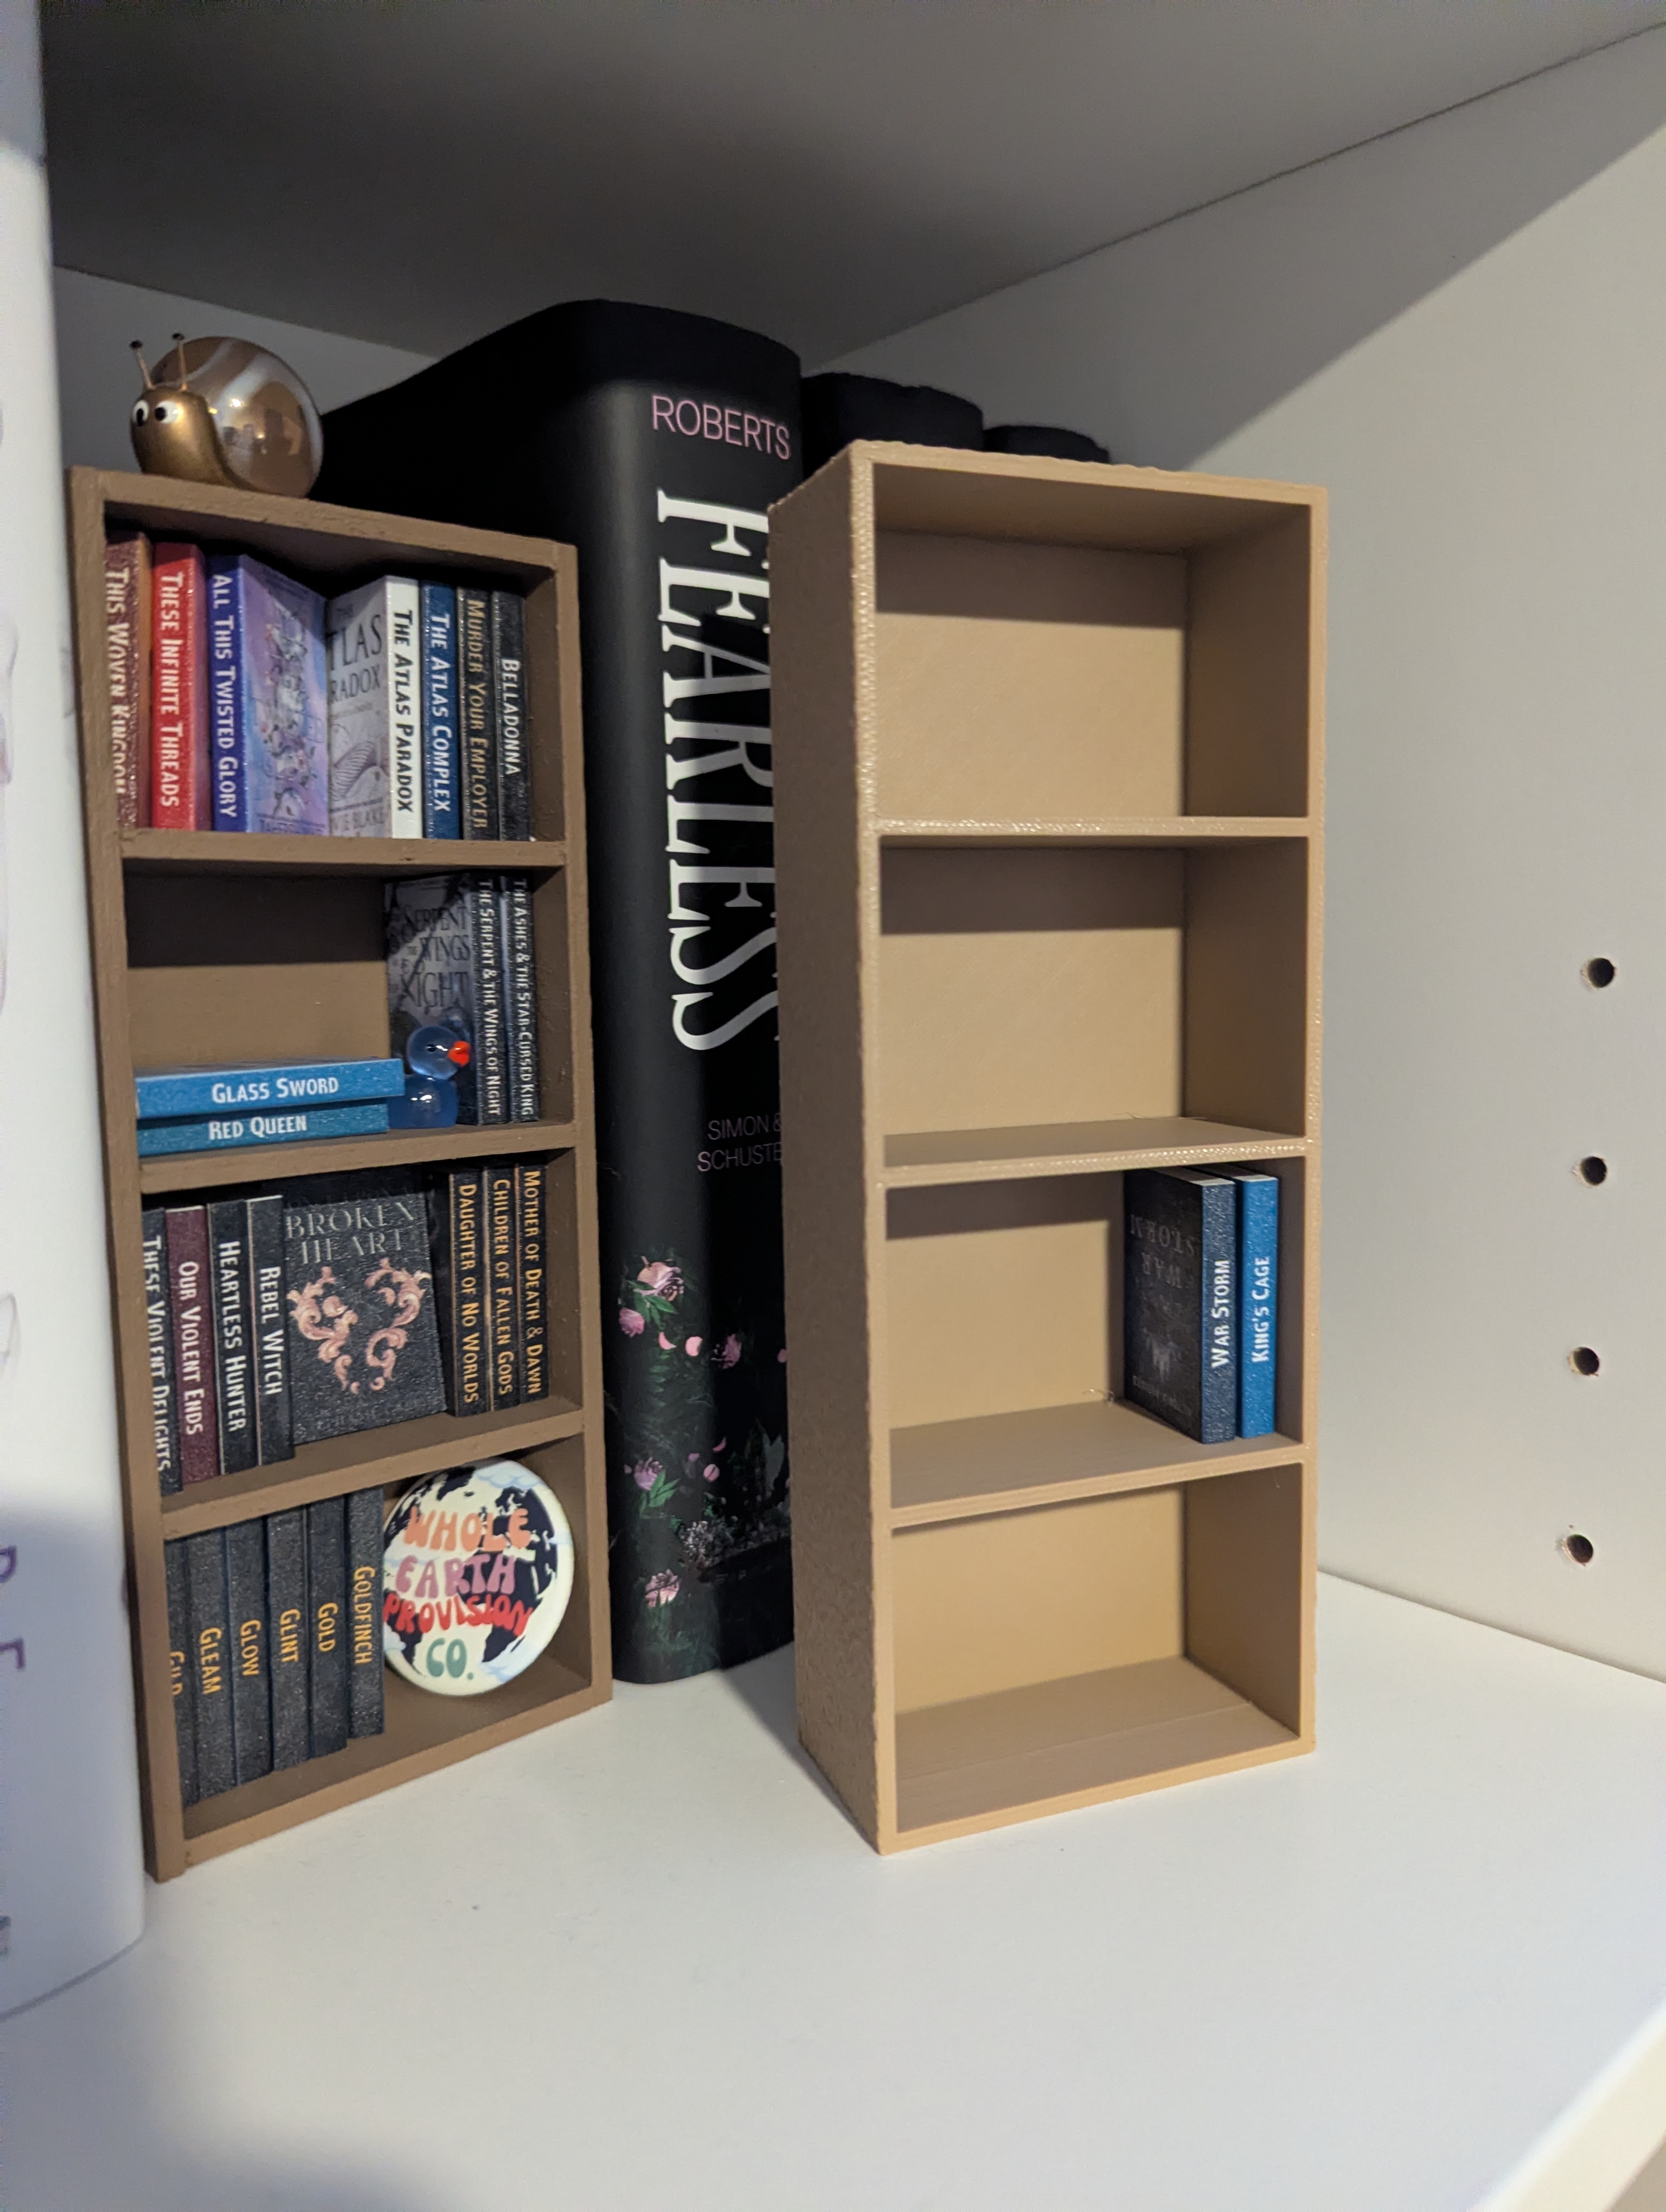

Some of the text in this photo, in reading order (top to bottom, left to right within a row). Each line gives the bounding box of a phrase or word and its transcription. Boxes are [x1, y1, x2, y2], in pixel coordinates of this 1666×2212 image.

[651, 394, 791, 460] ROBERTS
[106, 567, 130, 615] THIS
[108, 621, 130, 697] WOVEN
[160, 572, 183, 808] THESE INFINITE THREADS
[213, 574, 239, 818] ALL THIS TWISTED GLORY
[393, 609, 414, 813] THE ATLAS PARADOX
[431, 614, 452, 812] THE ATLAS COMPLEX
[467, 599, 488, 829] MURDER YOUR EMPLOYER
[501, 658, 521, 776] BELLADONNA
[656, 487, 779, 1051] FEARLESS
[479, 881, 501, 1116] THE SERPENT & THE WINGS OF NIGHT
[514, 878, 534, 1116] THE ASHES & THE STAR-CURSED KING
[208, 1115, 307, 1141] RED QUEEN
[212, 1076, 338, 1105] GLASS SWORD
[707, 1114, 769, 1140] SIMON
[697, 1141, 781, 1172] SCHUSTE
[285, 1201, 415, 1240] BROKEN
[300, 1227, 402, 1266] HEART
[142, 1235, 162, 1295] THESE
[459, 1184, 479, 1403] DAUGHTER OF NO WORLDS
[493, 1179, 515, 1396] CHILDREN OF FALLEN GODS
[523, 1170, 544, 1394] MOTHER OF DEATH & DAWN
[177, 1261, 204, 1436] OUR VIOLENT ENDS
[219, 1240, 247, 1433] HEARTLESS HUNTER
[259, 1266, 285, 1396] REBEL WITCH
[1211, 1259, 1230, 1369] WAR STORM
[1251, 1256, 1270, 1362] KING'S CAGE
[403, 1507, 534, 1553] WHOLE
[353, 1566, 376, 1665] GOLDFINCH
[384, 1592, 534, 1637] PROVISION
[395, 1554, 516, 1598] EARTH
[198, 1627, 222, 1695] GLEAM
[240, 1619, 261, 1676] GLOW
[279, 1608, 302, 1663] GLINT
[317, 1602, 339, 1652] GOLD
[426, 1637, 475, 1680] CO.
